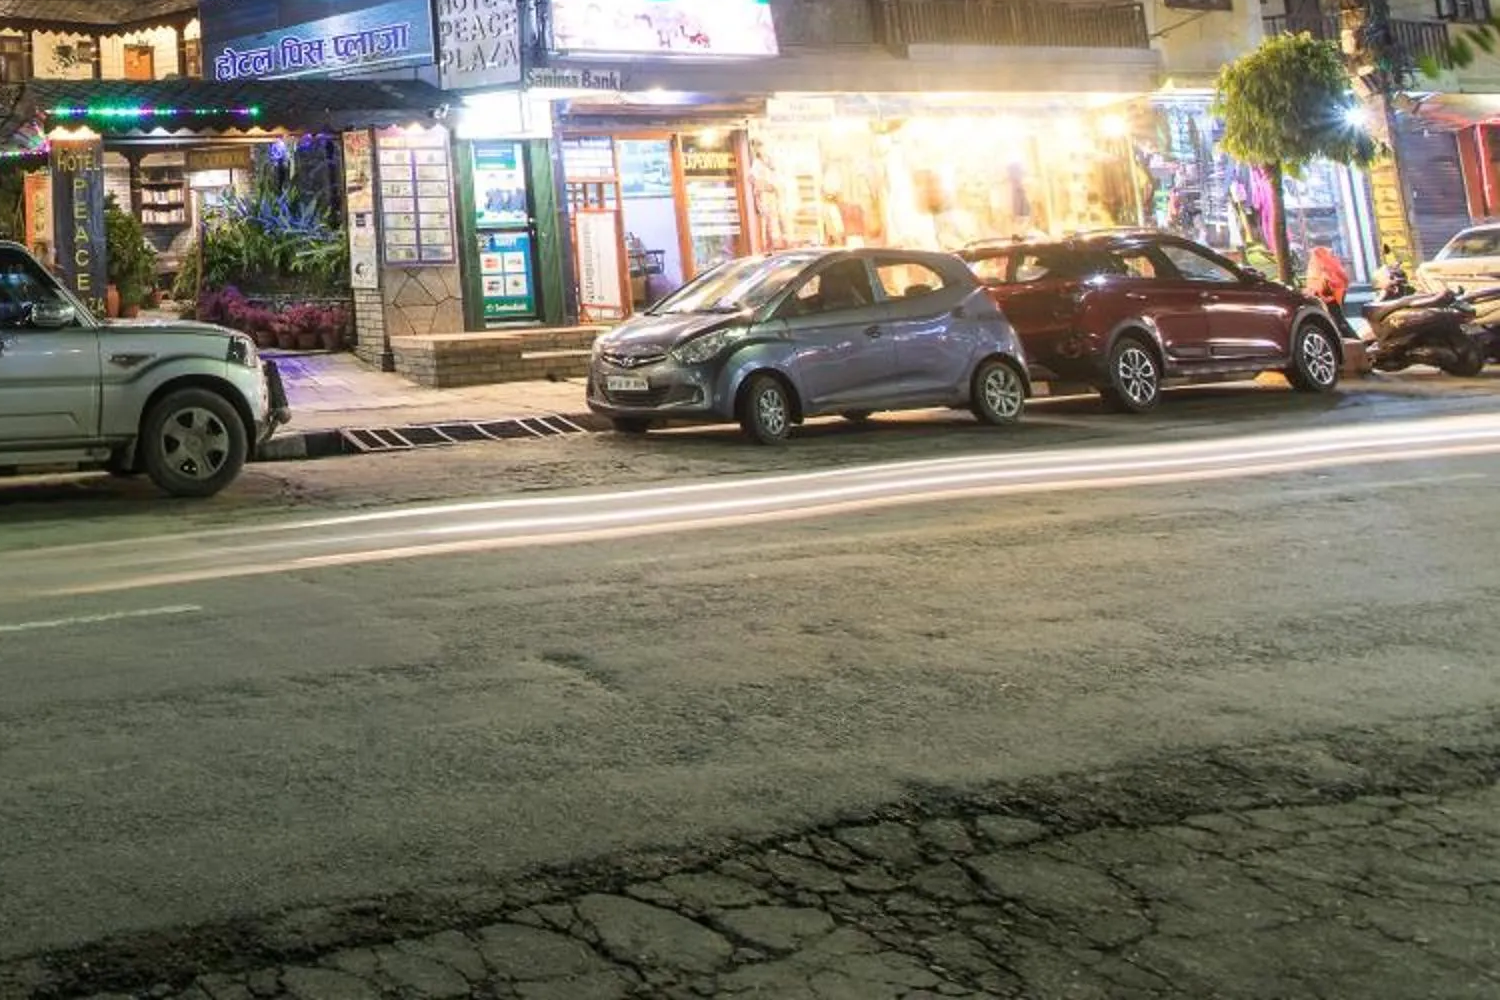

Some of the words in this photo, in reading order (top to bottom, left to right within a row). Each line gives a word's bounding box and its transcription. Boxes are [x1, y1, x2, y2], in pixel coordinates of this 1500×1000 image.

[440, 9, 517, 44] PEACE
[440, 40, 519, 74] PLAZA
[581, 69, 619, 89] Bank
[57, 151, 100, 172] HOTEL
[73, 177, 91, 291] PEACE
